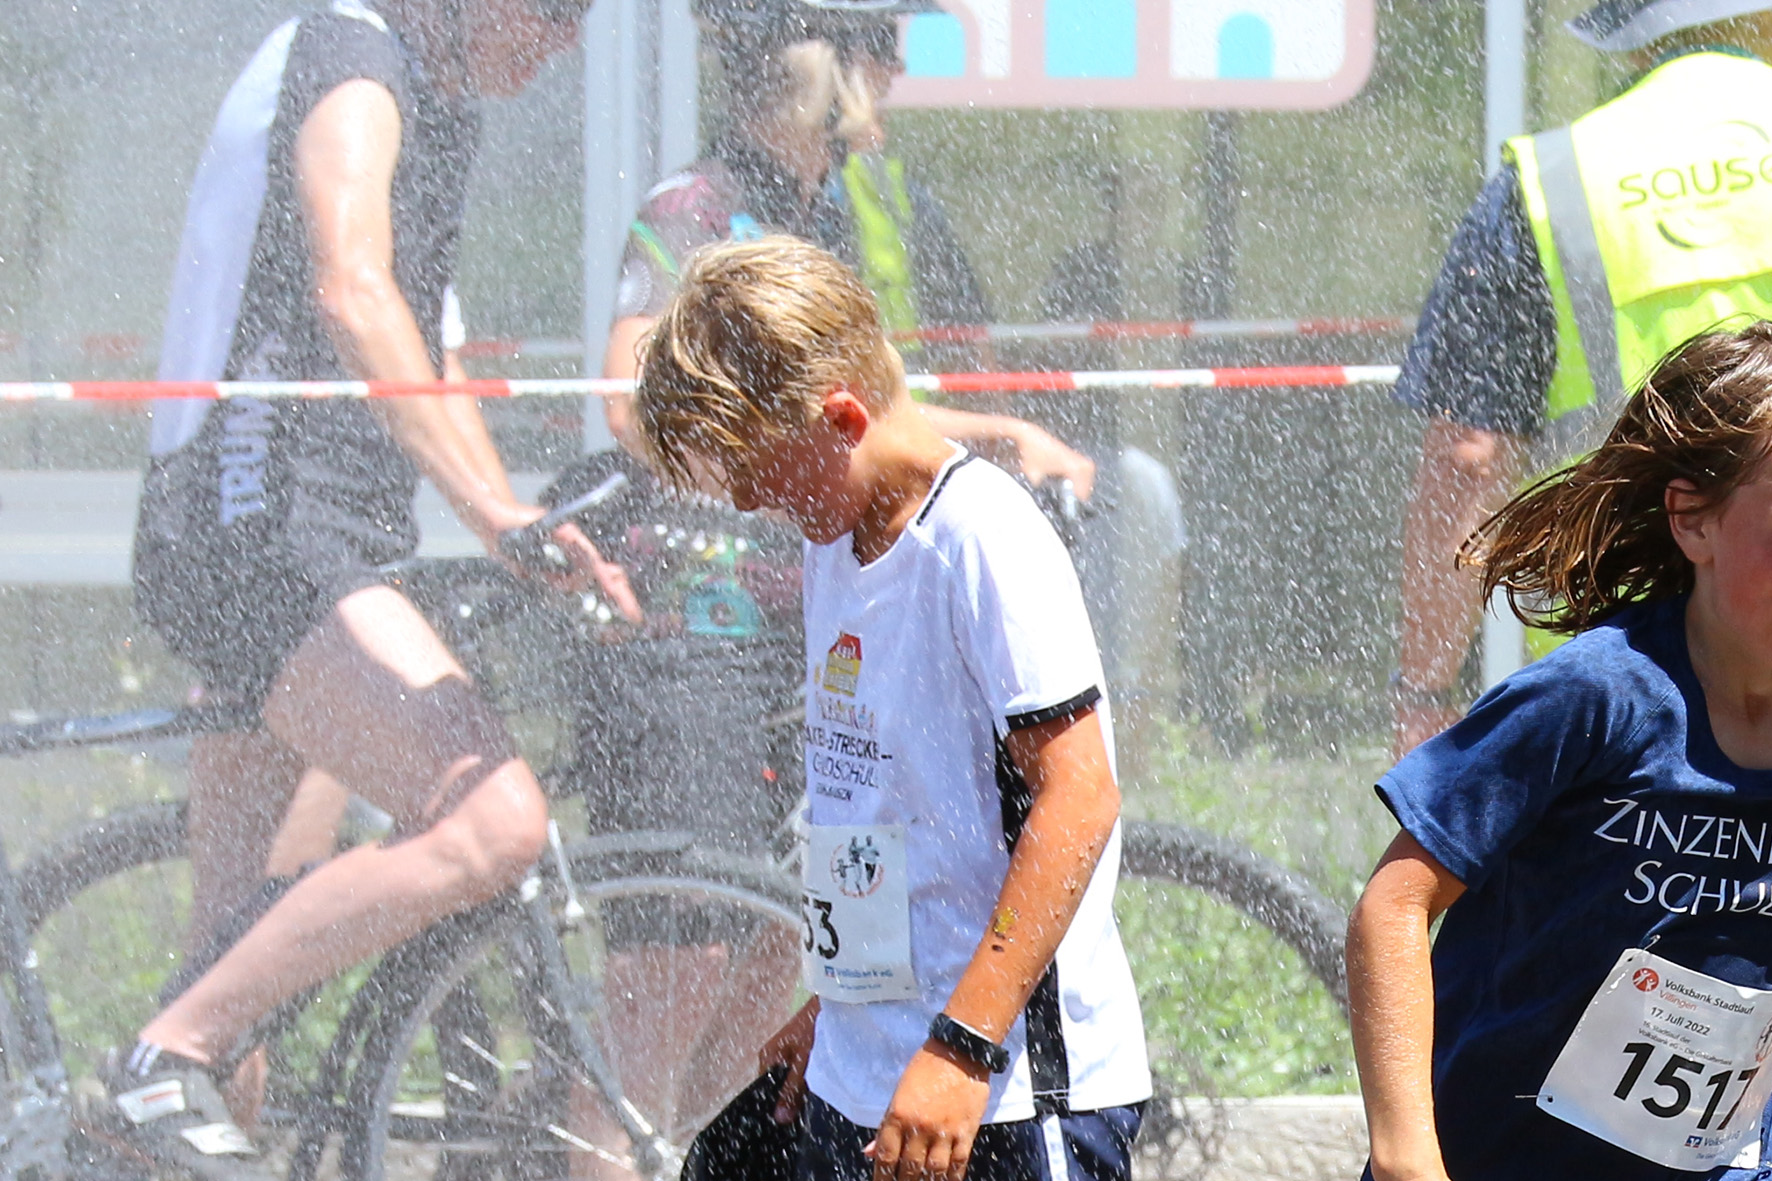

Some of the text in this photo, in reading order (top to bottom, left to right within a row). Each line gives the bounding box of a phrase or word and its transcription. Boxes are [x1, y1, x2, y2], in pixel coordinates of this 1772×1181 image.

[1660, 990, 1698, 1011] Villingen
[1664, 979, 1755, 1015] Volksbank Stadtlauf
[1651, 1006, 1711, 1036] 17. Juli 2022
[1613, 1042, 1762, 1131] 1517
